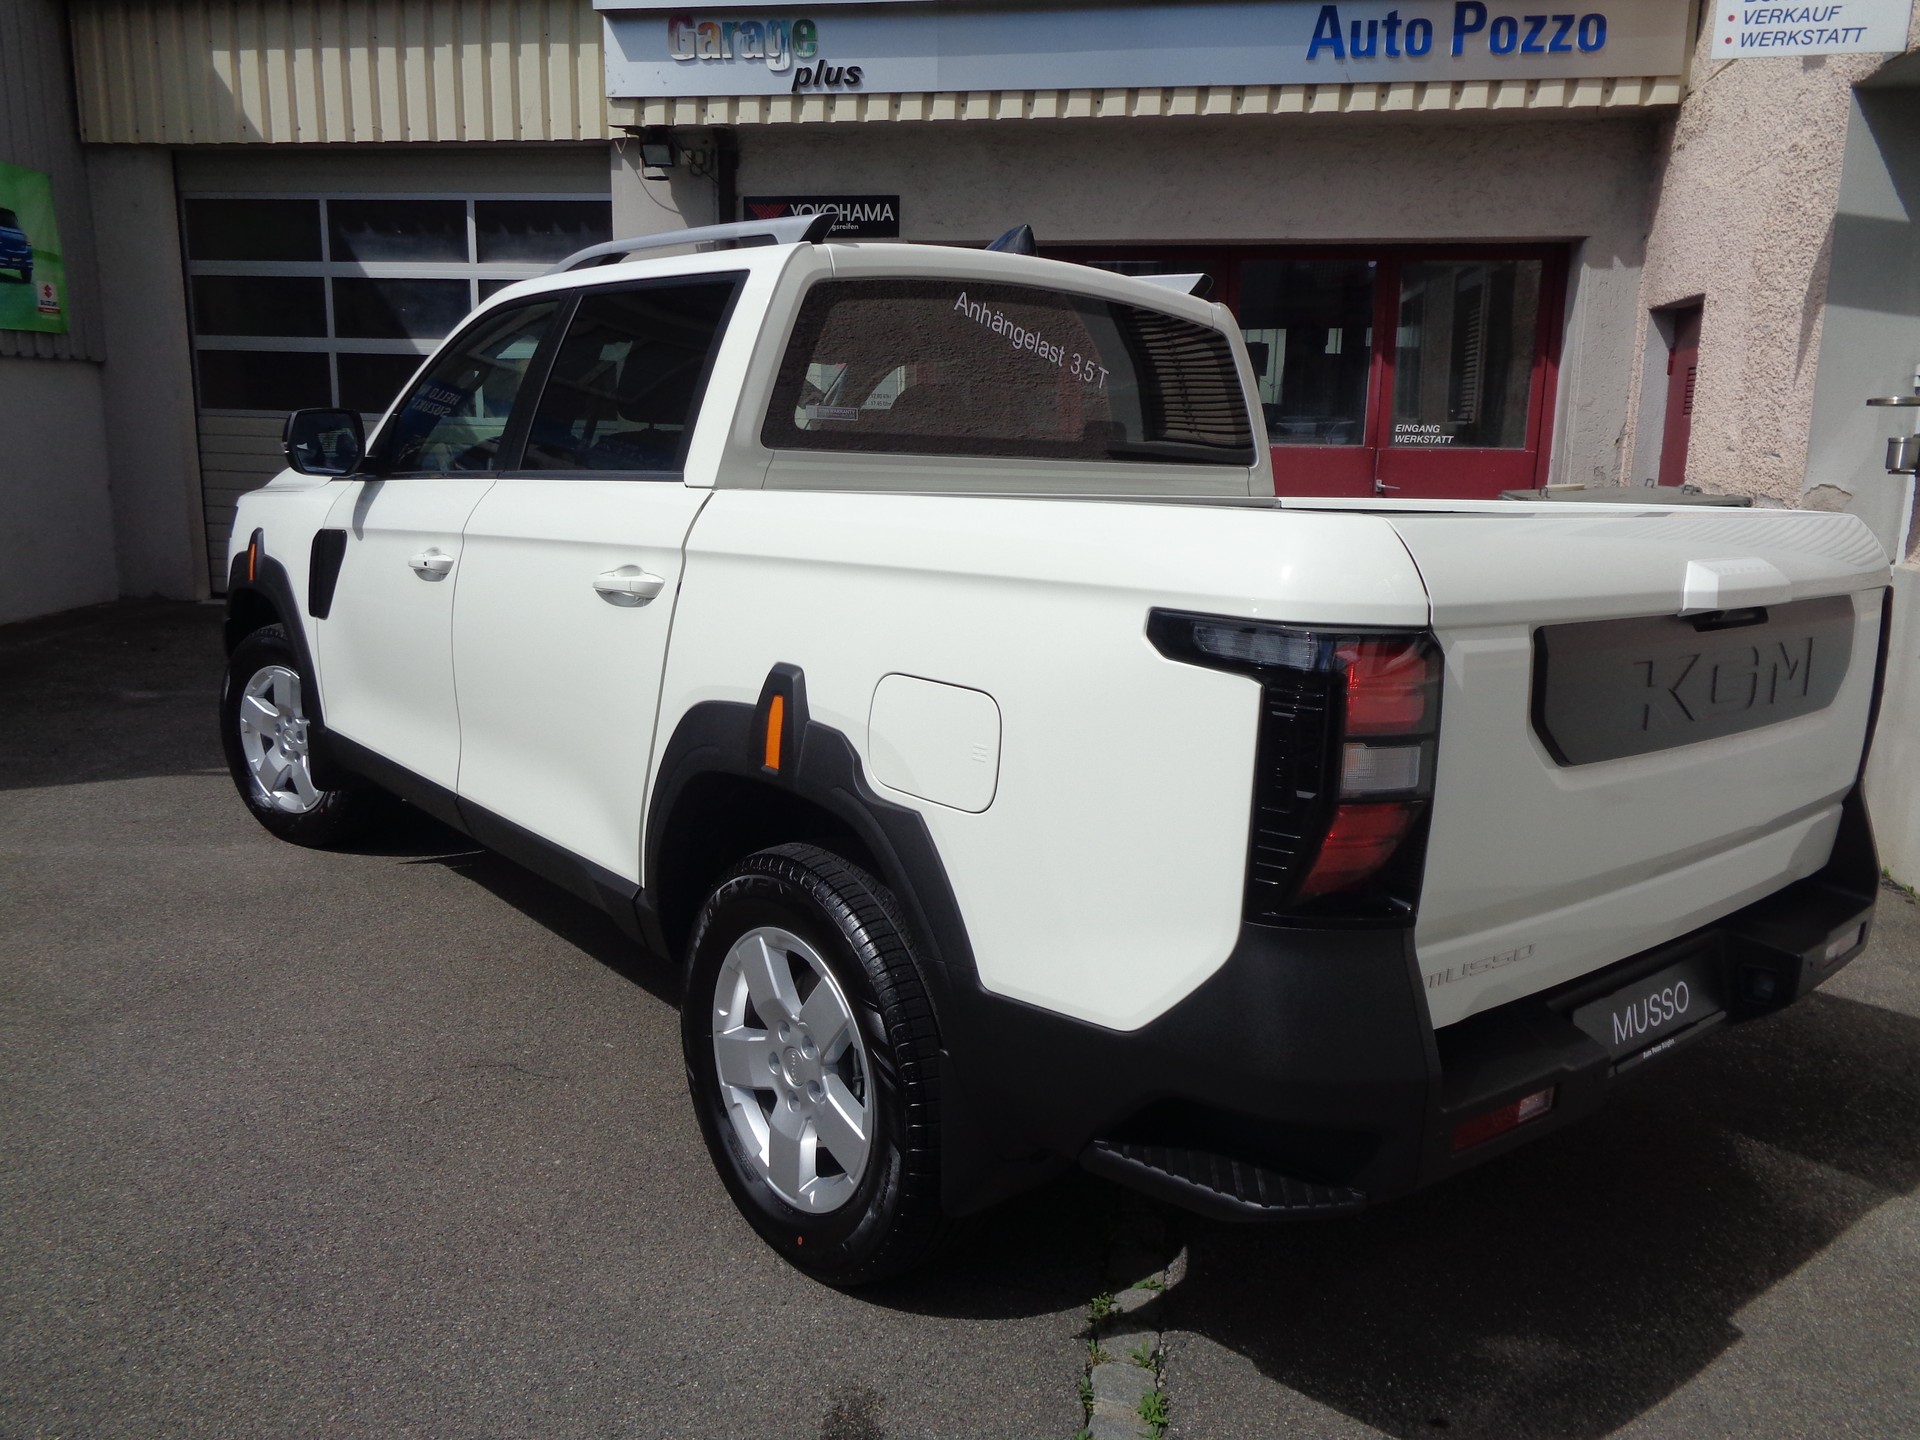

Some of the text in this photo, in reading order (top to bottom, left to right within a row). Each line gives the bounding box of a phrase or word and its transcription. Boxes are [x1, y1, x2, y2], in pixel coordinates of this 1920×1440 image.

[1306, 1, 1607, 60] Auto Pozzo
[1743, 6, 1842, 25] VERKAUF
[667, 14, 818, 71] Garage
[1740, 27, 1868, 47] WERKSTATT
[792, 60, 862, 93] plus
[831, 223, 859, 232] gsreifen
[954, 291, 1065, 367] Anhängelast
[1395, 424, 1440, 433] EINGANG
[1395, 435, 1454, 444] WERKSTATT
[1633, 637, 1813, 731] KGM
[1612, 981, 1689, 1045] MUSSO
